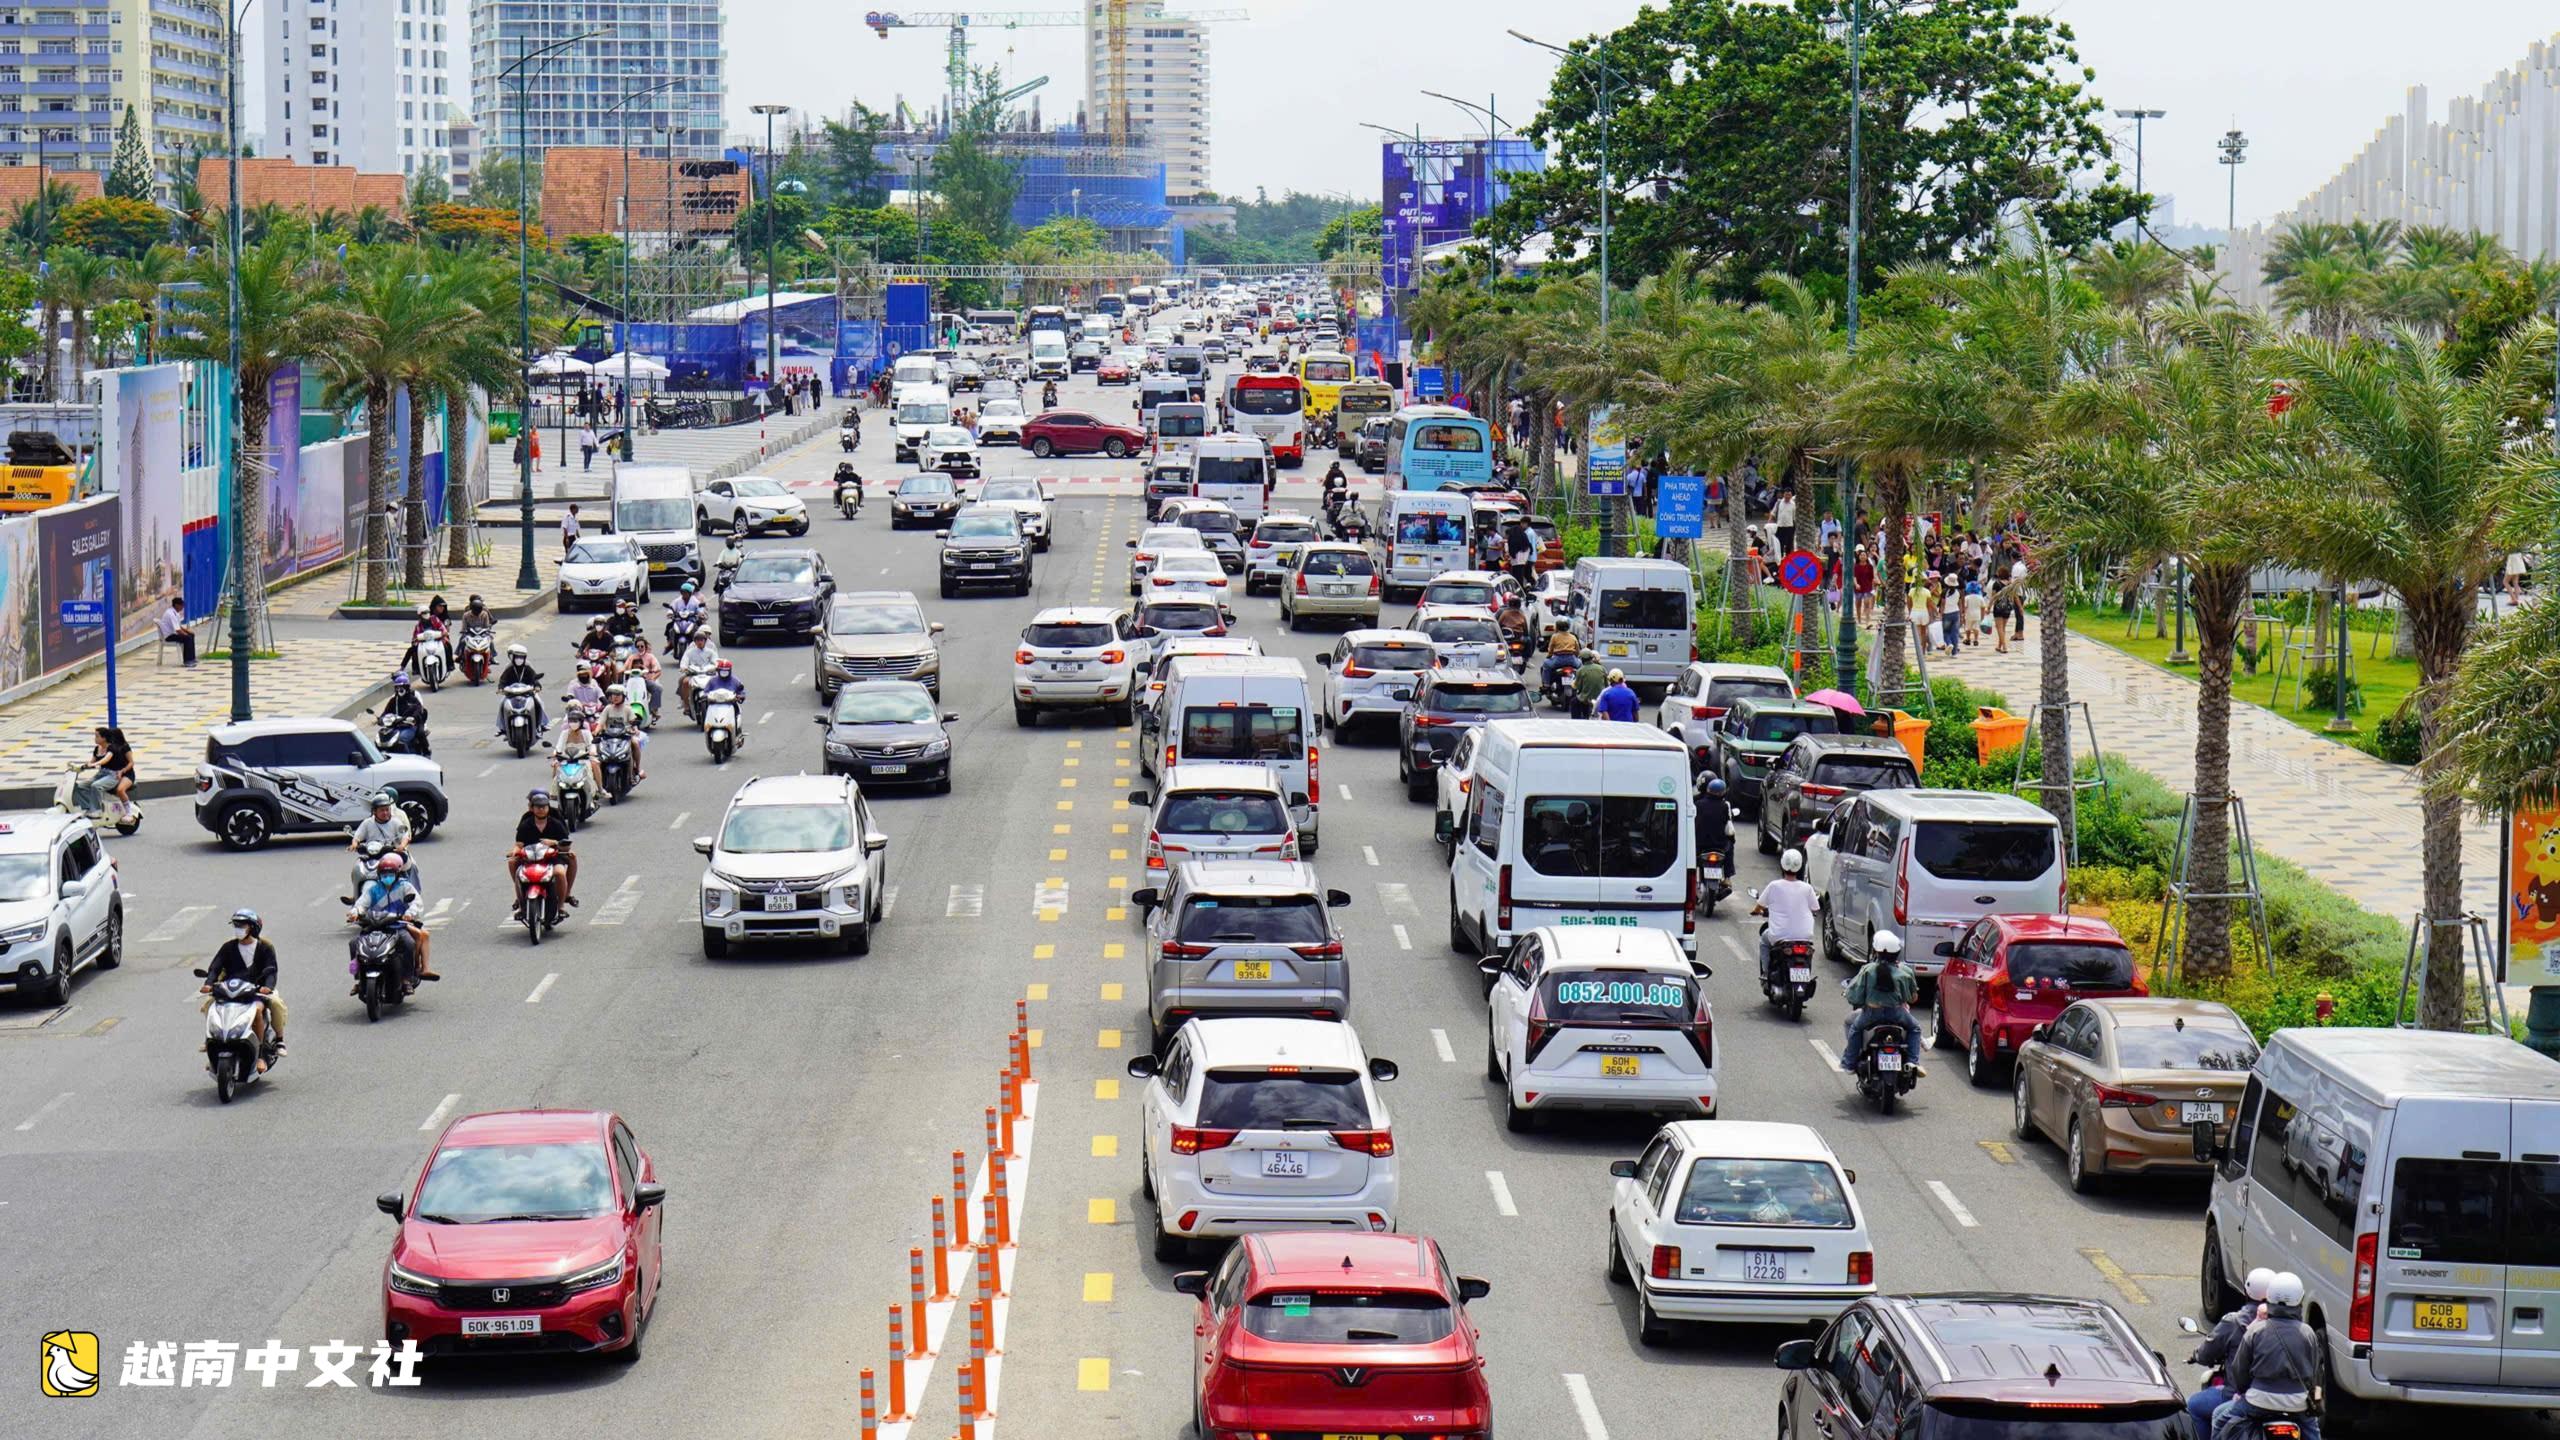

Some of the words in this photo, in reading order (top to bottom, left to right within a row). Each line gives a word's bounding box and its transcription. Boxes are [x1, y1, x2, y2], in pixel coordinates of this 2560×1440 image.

[1406, 216, 1435, 224] TRNH
[781, 366, 814, 374] YAMAHA
[72, 535, 90, 556] SALES
[89, 529, 111, 551] GALLERY
[773, 895, 788, 903] 51H
[1559, 981, 1684, 1008] 0852.000.808
[1612, 1056, 1630, 1065] 60H
[1605, 1065, 1637, 1075] 369.43
[2195, 1103, 2212, 1112] 70A
[1275, 1152, 1295, 1163] 51L
[1267, 1163, 1303, 1174] 464.46
[1754, 1252, 1777, 1265] 61A
[1747, 1266, 1785, 1280] 122.26
[2401, 1268, 2449, 1277] TRANSIT
[2429, 1304, 2453, 1316] 60B
[468, 1319, 534, 1333] 60K-961.09
[2420, 1316, 2463, 1329] 044.83
